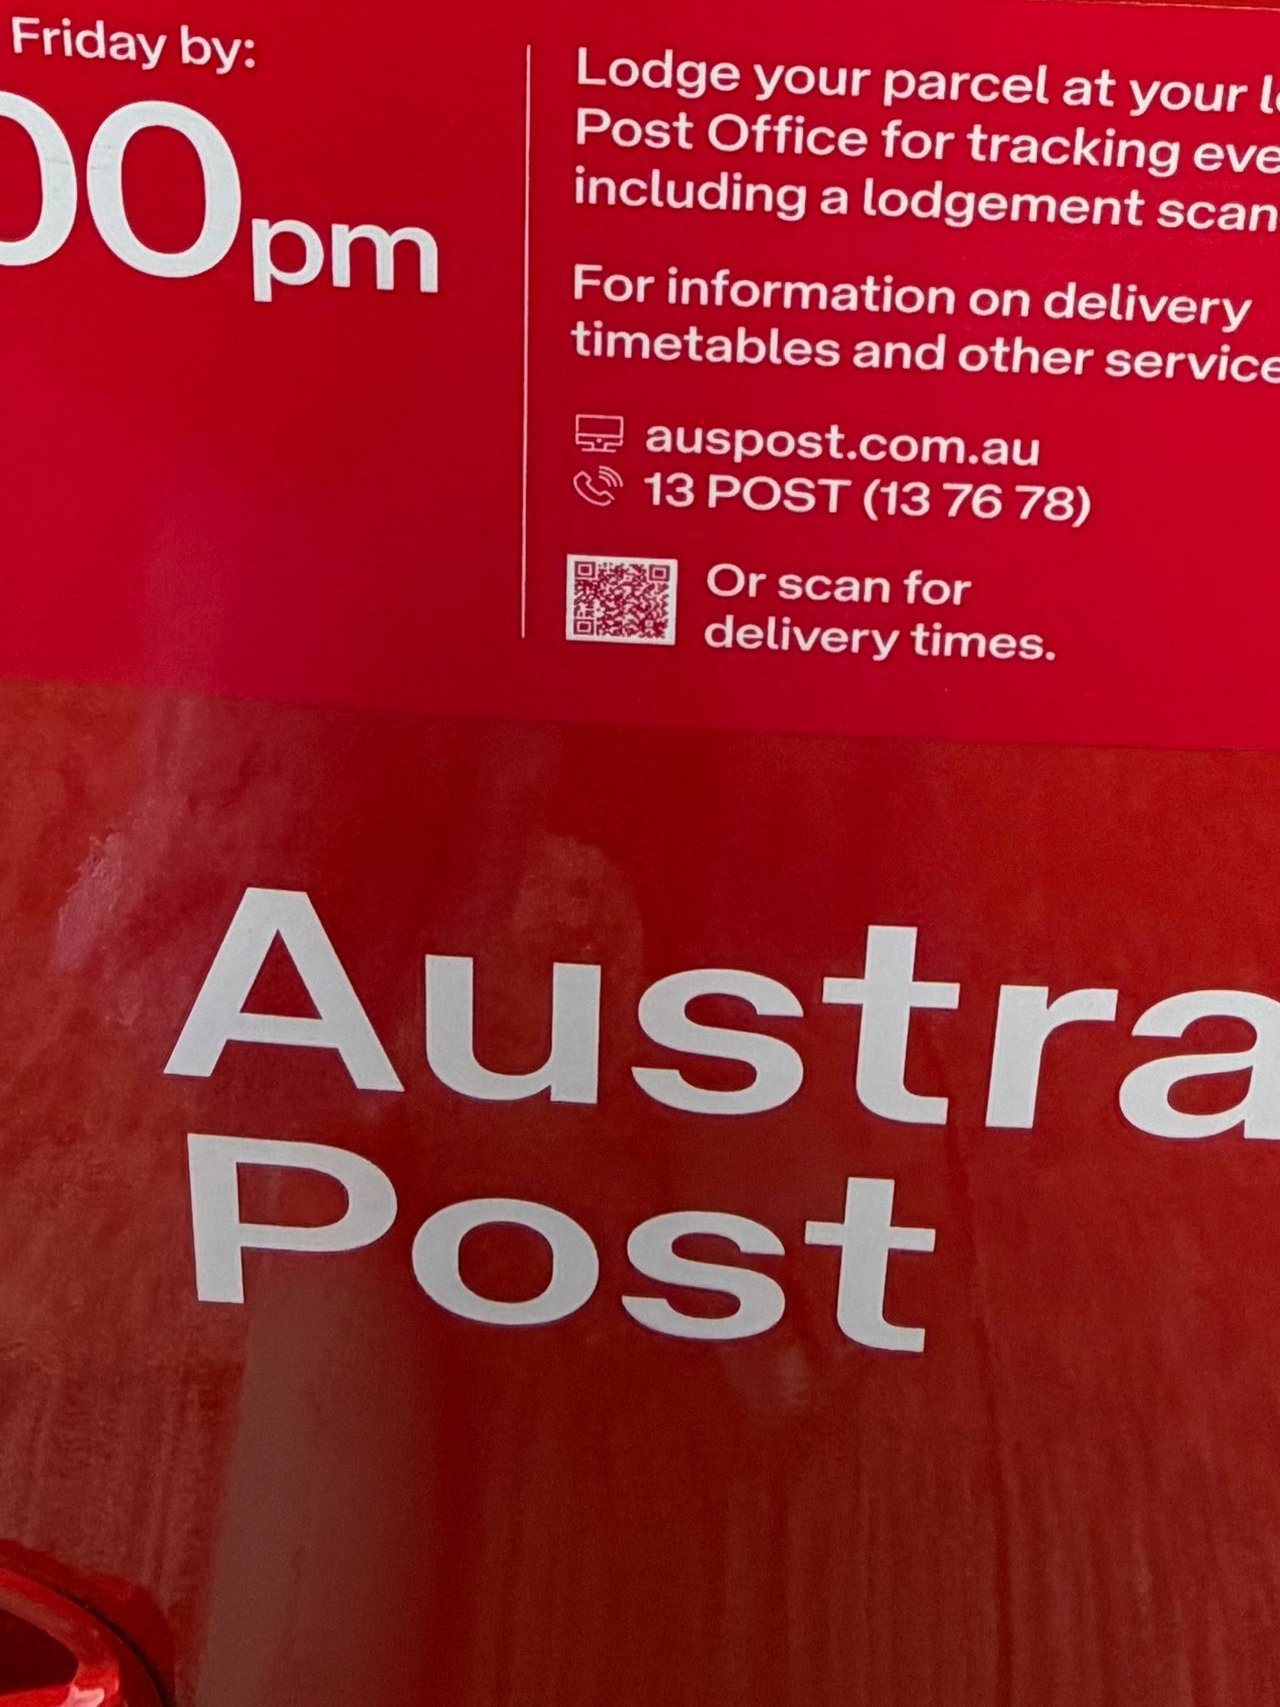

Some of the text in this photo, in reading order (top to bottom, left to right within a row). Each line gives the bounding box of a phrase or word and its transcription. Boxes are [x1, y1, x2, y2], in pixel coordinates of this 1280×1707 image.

[11, 16, 167, 70] Friday
[180, 24, 255, 75] by:
[577, 46, 740, 99] Lodge
[753, 64, 871, 101] your
[883, 64, 1049, 106] parcel
[1062, 69, 1116, 107] at
[1129, 80, 1248, 116] your
[576, 107, 693, 149] Post
[708, 113, 868, 157] Office
[881, 119, 955, 159] for
[966, 124, 1180, 177] tracking
[575, 165, 807, 222] including
[820, 187, 848, 215] a
[863, 177, 1145, 228] lodgement
[573, 263, 1252, 333] For information on delivery
[570, 320, 840, 367] timetables
[852, 333, 946, 370] and
[958, 336, 1094, 375] other
[645, 424, 1040, 466] auspost.com.au
[644, 472, 1091, 528] 13 POST (13 76 78)
[706, 563, 972, 605] Or scan for
[704, 614, 1056, 662] delivery times.
[186, 1132, 937, 1353] Post
